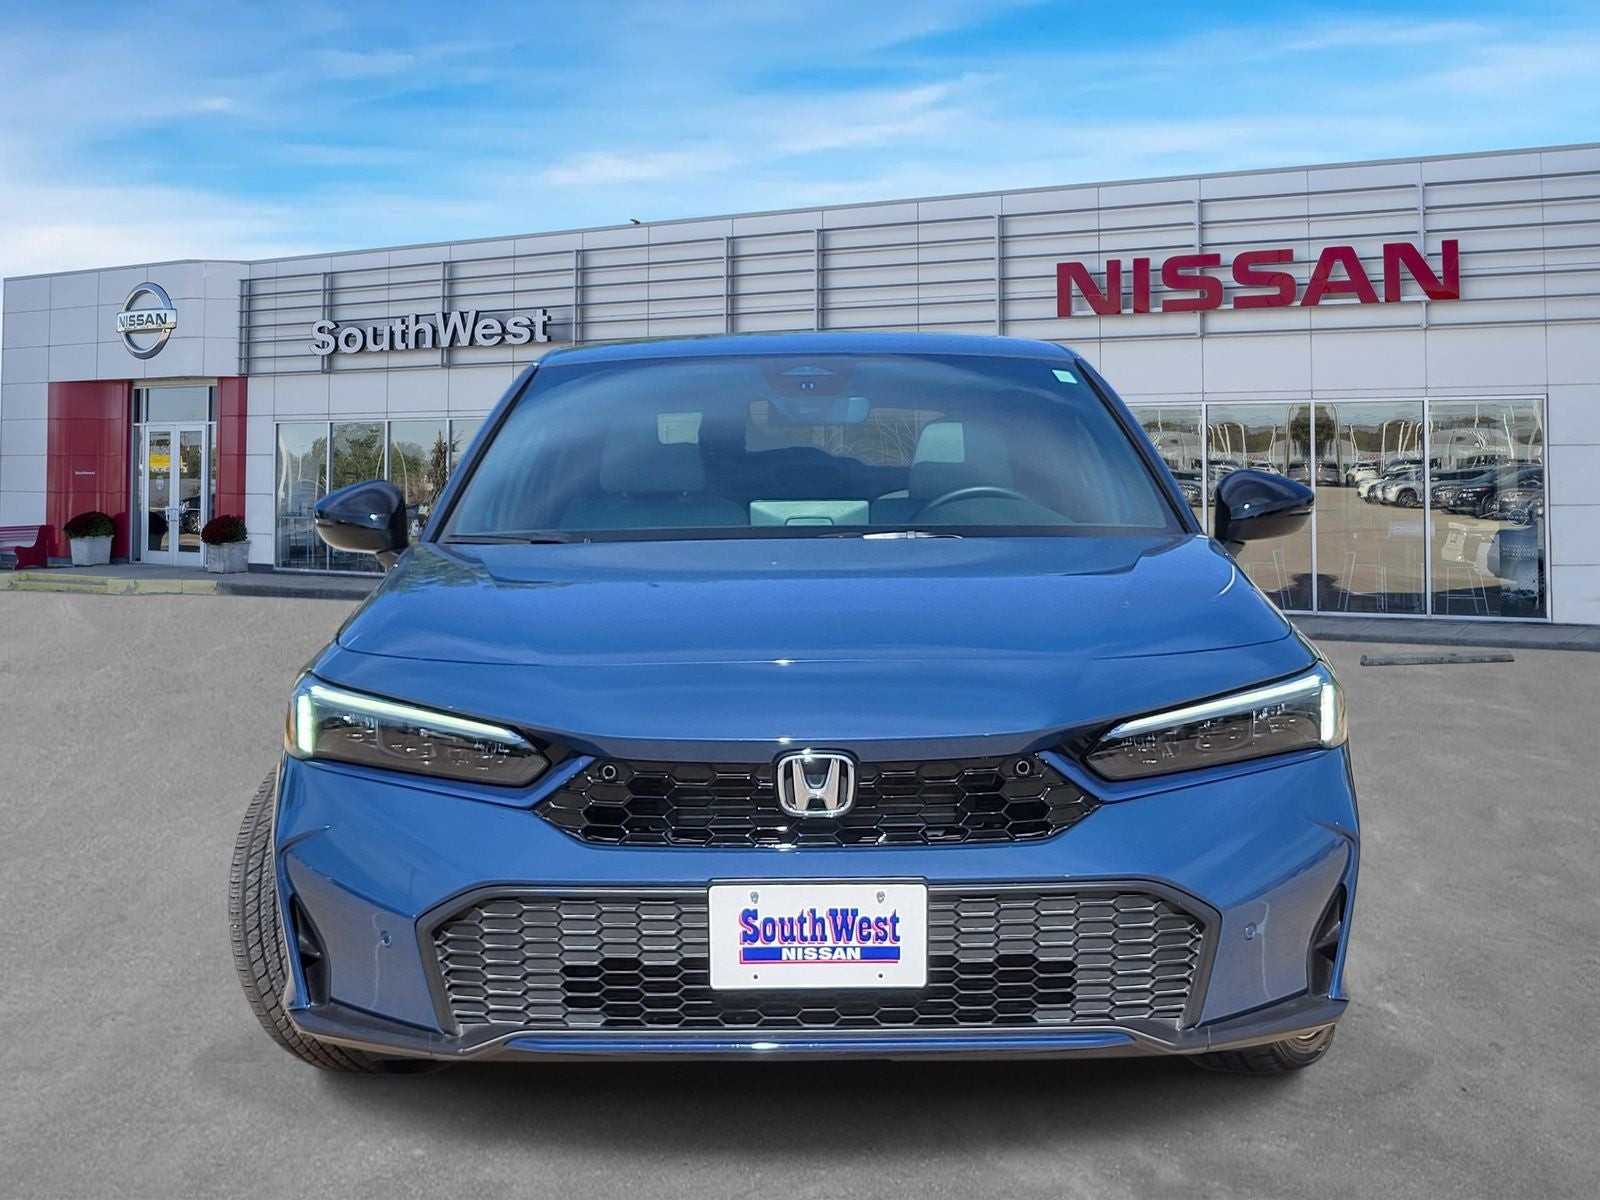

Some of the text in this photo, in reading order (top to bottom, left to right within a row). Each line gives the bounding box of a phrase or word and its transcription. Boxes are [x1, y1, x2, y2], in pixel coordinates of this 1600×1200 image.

[1056, 239, 1460, 318] NISSAN
[119, 312, 167, 328] NISSAN
[309, 309, 552, 356] SouthWest
[739, 908, 901, 945] SouthWest
[781, 947, 861, 961] NISSAN
